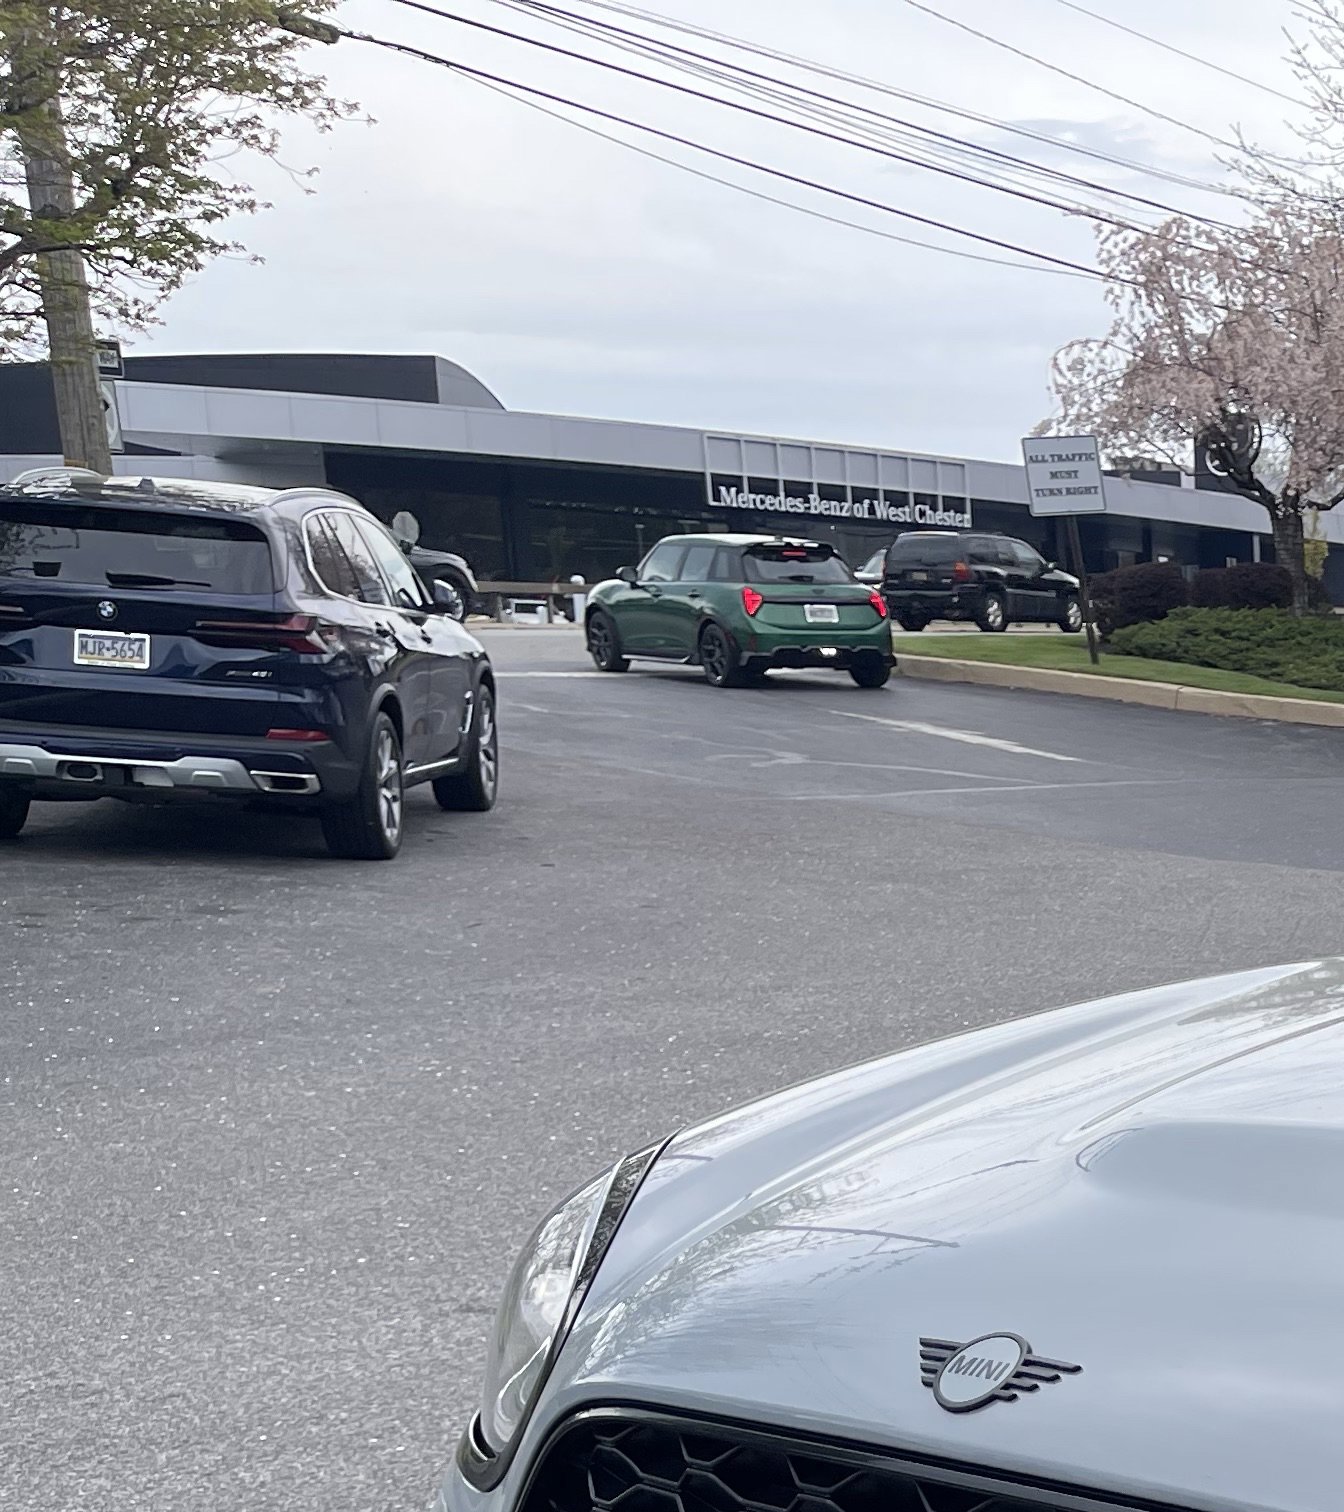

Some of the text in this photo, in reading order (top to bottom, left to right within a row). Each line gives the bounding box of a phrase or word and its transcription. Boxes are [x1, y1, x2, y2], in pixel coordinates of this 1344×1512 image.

[1029, 452, 1095, 463] ALL TRAFFIC
[1049, 470, 1079, 479] MUST
[1034, 486, 1099, 497] TURN RIGHT
[718, 486, 972, 528] Mercedes-Benz of West Chester
[948, 1355, 1011, 1381] MINI
